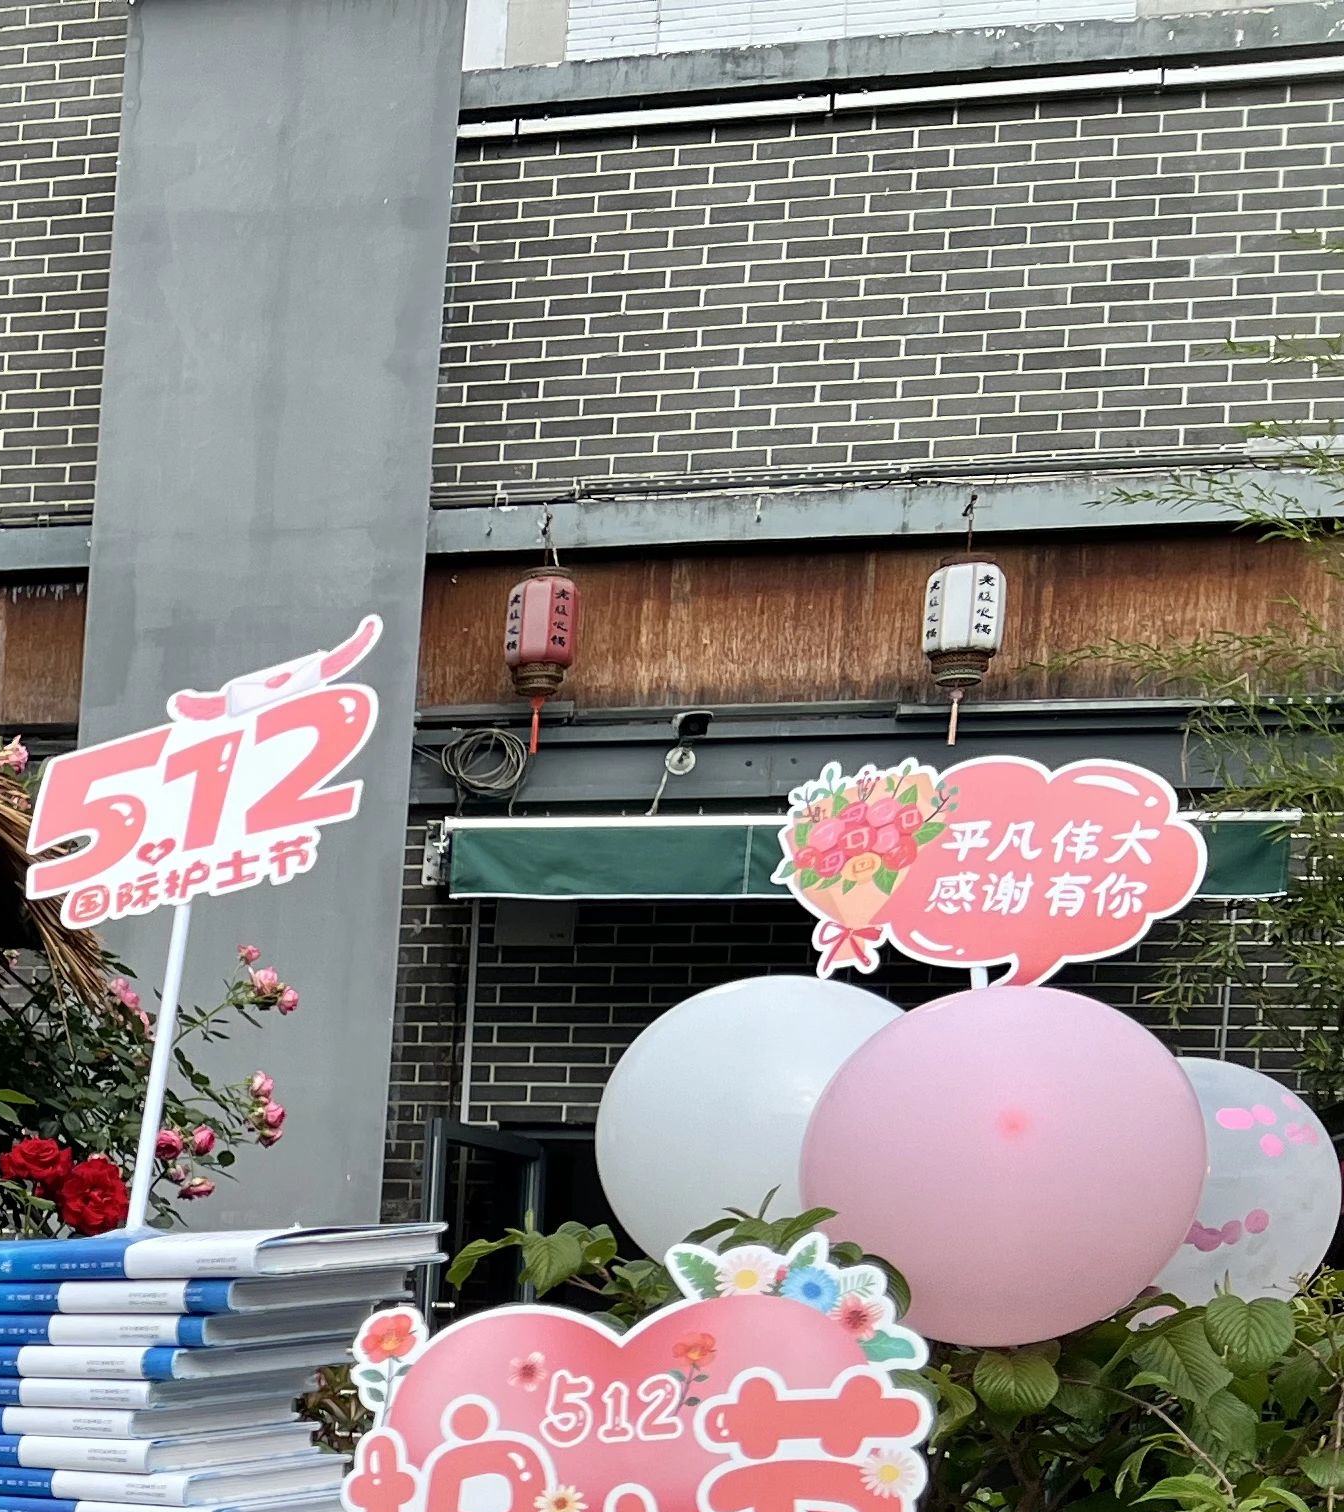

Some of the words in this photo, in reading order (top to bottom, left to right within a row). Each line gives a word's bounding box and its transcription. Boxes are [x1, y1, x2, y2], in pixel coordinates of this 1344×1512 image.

[68, 834, 313, 924] 国际护士节
[539, 1369, 684, 1449] 512
